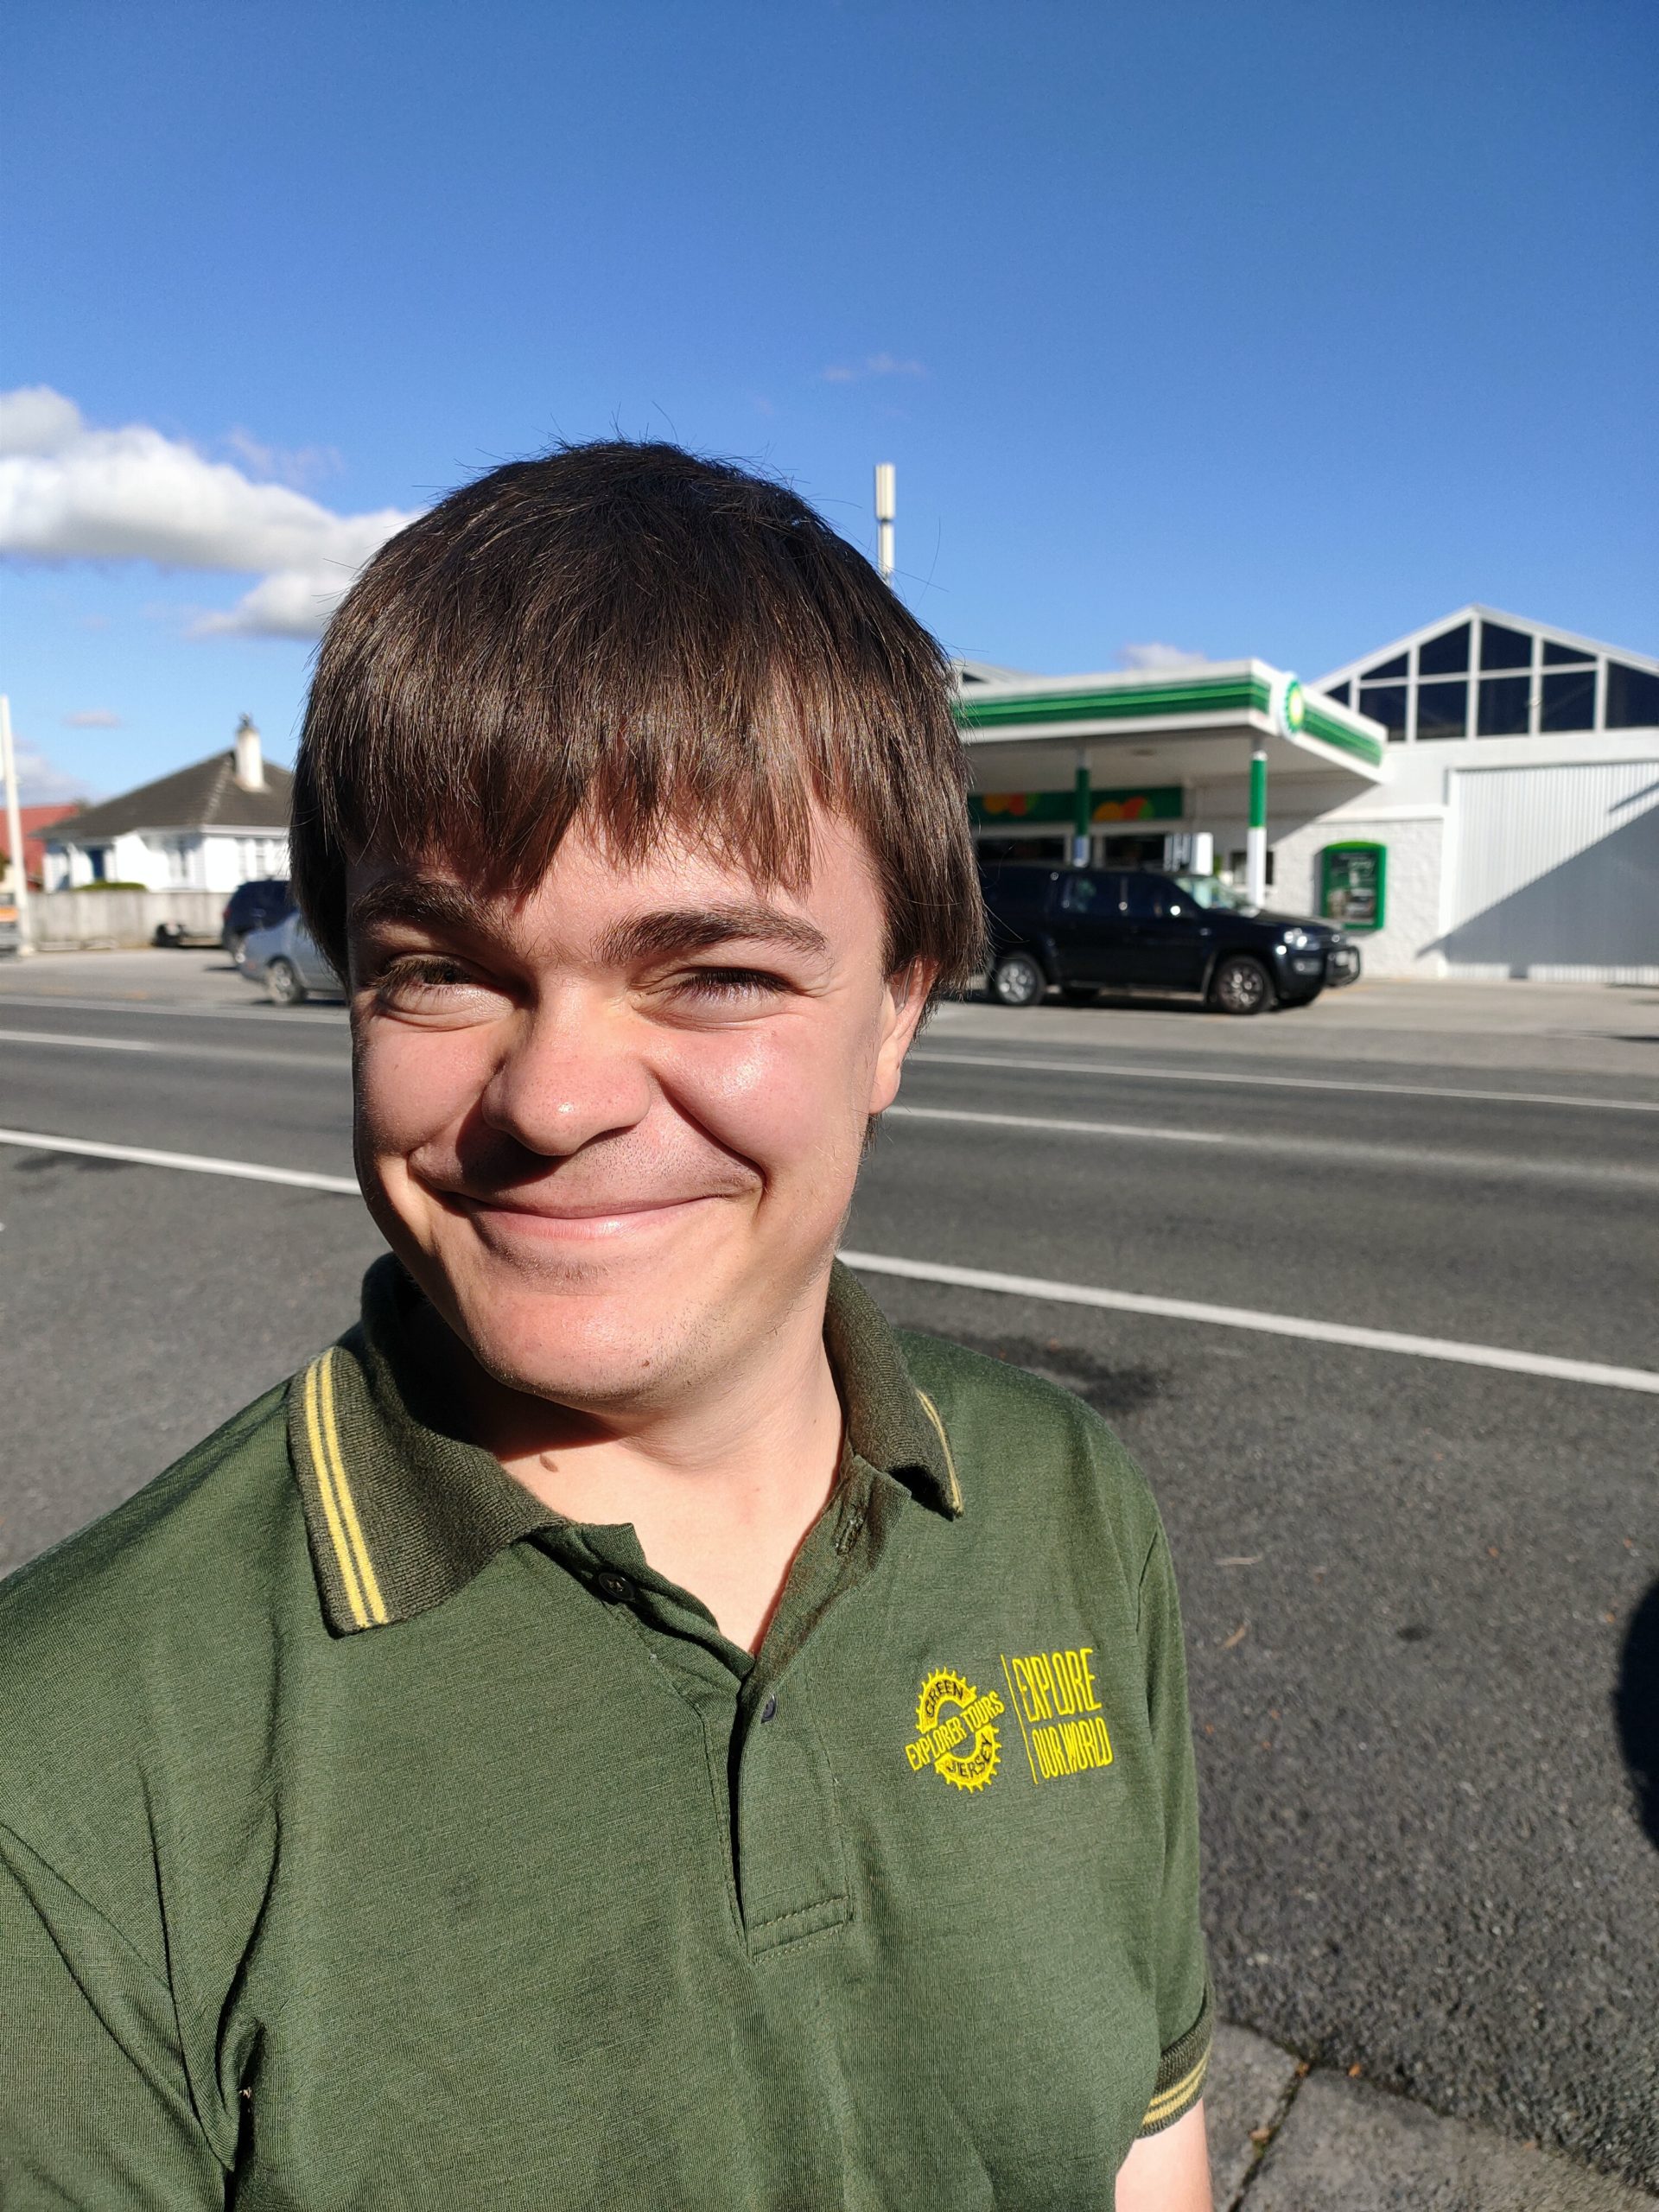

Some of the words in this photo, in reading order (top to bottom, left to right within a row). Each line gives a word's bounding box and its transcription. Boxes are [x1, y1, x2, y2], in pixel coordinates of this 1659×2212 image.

[925, 1679, 963, 1718] GREEN
[1012, 1648, 1102, 1722] EXPLORE
[905, 1716, 968, 1771] EXPLORER
[960, 1690, 1005, 1732] TOURS
[945, 1732, 993, 1778] JERSEY
[1032, 1726, 1071, 1779] OUR
[1058, 1717, 1113, 1774] WORLD
